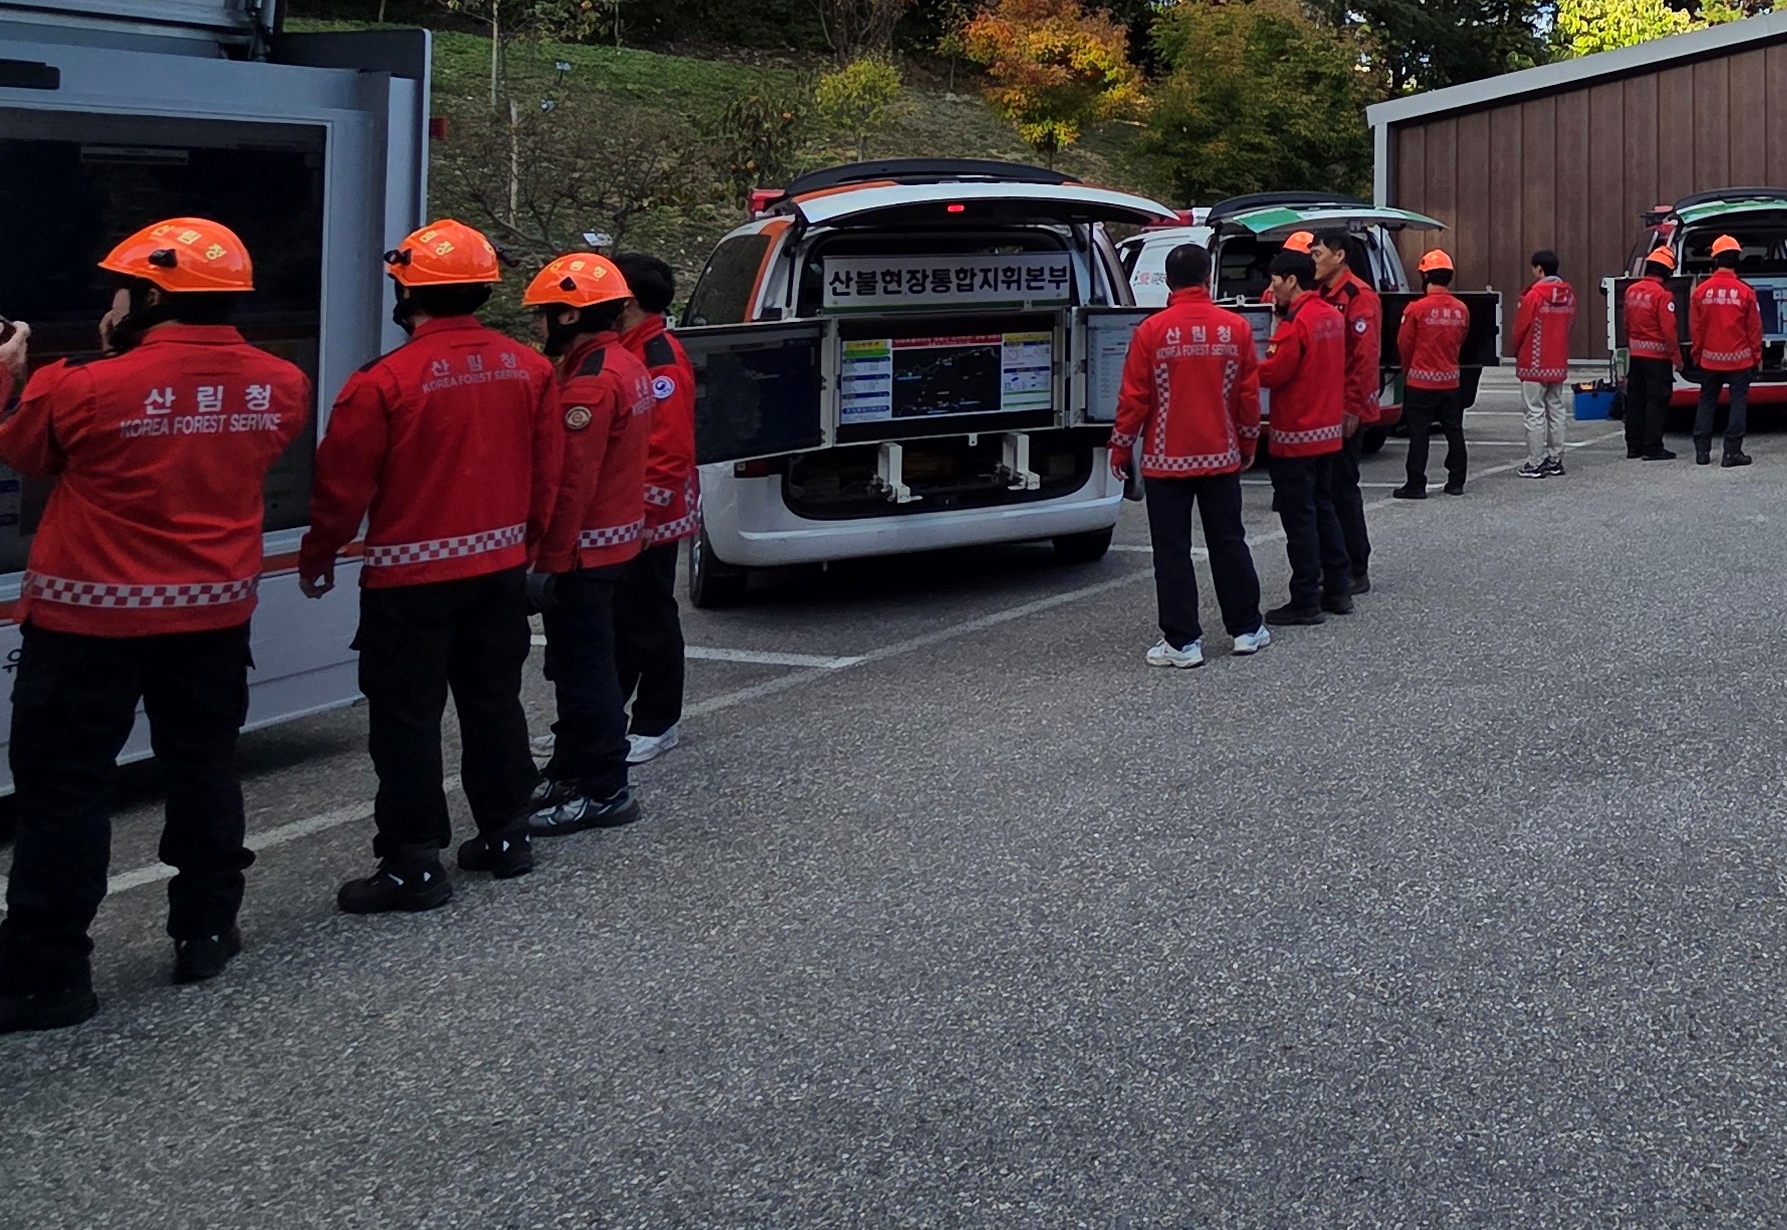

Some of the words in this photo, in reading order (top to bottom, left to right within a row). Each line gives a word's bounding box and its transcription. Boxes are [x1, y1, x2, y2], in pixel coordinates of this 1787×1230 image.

[143, 384, 272, 416] 산림청
[119, 419, 169, 439] KOREA
[173, 414, 228, 435] FOREST
